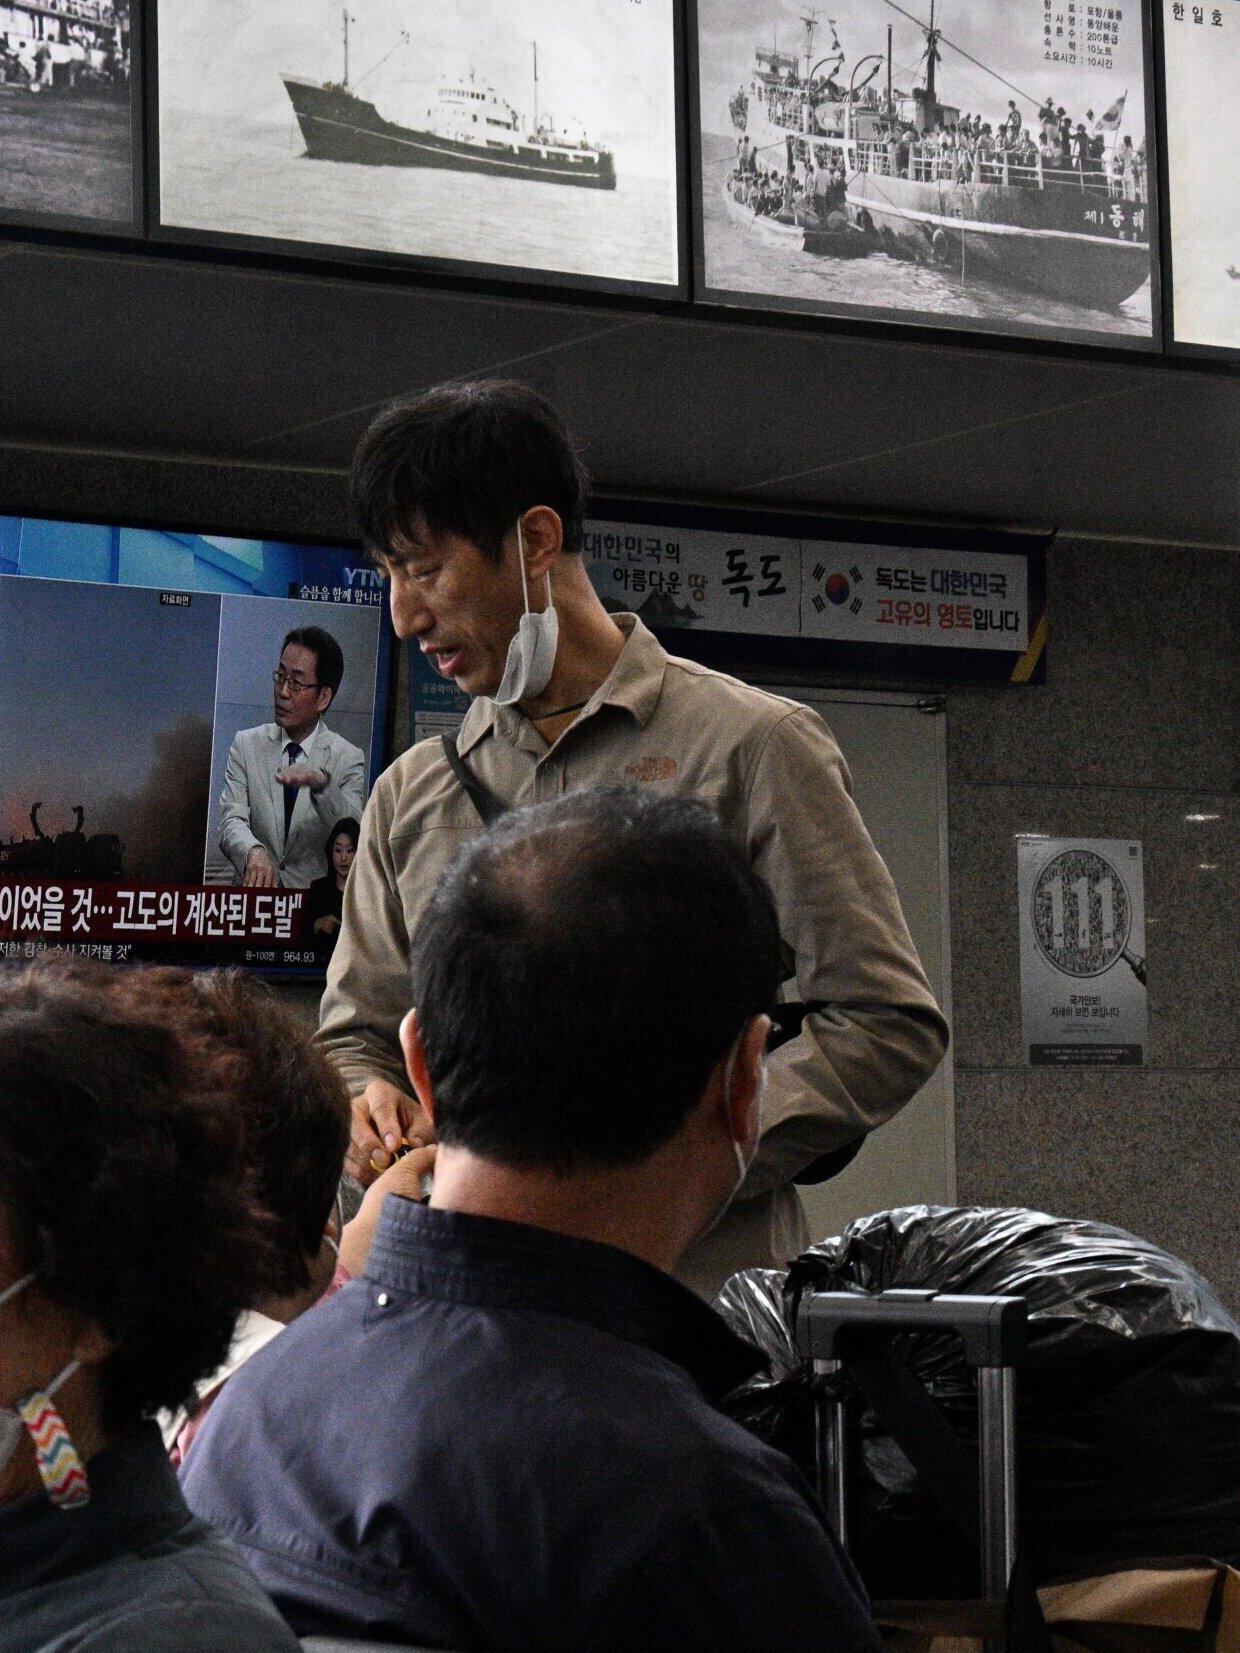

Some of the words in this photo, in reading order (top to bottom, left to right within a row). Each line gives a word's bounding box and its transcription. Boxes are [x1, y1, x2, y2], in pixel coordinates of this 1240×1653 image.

[1044, 51, 1076, 64] 소요시간
[1088, 57, 1113, 69] 10시간
[582, 533, 680, 564] 대한민국의
[343, 566, 383, 588] YTN
[613, 567, 681, 594] 아름다운
[688, 573, 708, 601] 땅
[722, 548, 786, 608] 독도
[876, 567, 926, 592] 독도는
[931, 569, 1008, 599] 대한민국
[161, 594, 190, 606] 자료화면
[300, 584, 330, 600] 슬픔을
[332, 586, 352, 602] 함께
[354, 588, 383, 605] 합니다
[876, 599, 930, 627] 고유의
[936, 603, 1020, 632] 영토입니다
[184, 892, 247, 937] 계산된
[251, 893, 303, 939] 도발"
[79, 943, 113, 959] 지켜볼
[283, 951, 315, 963] 964.93
